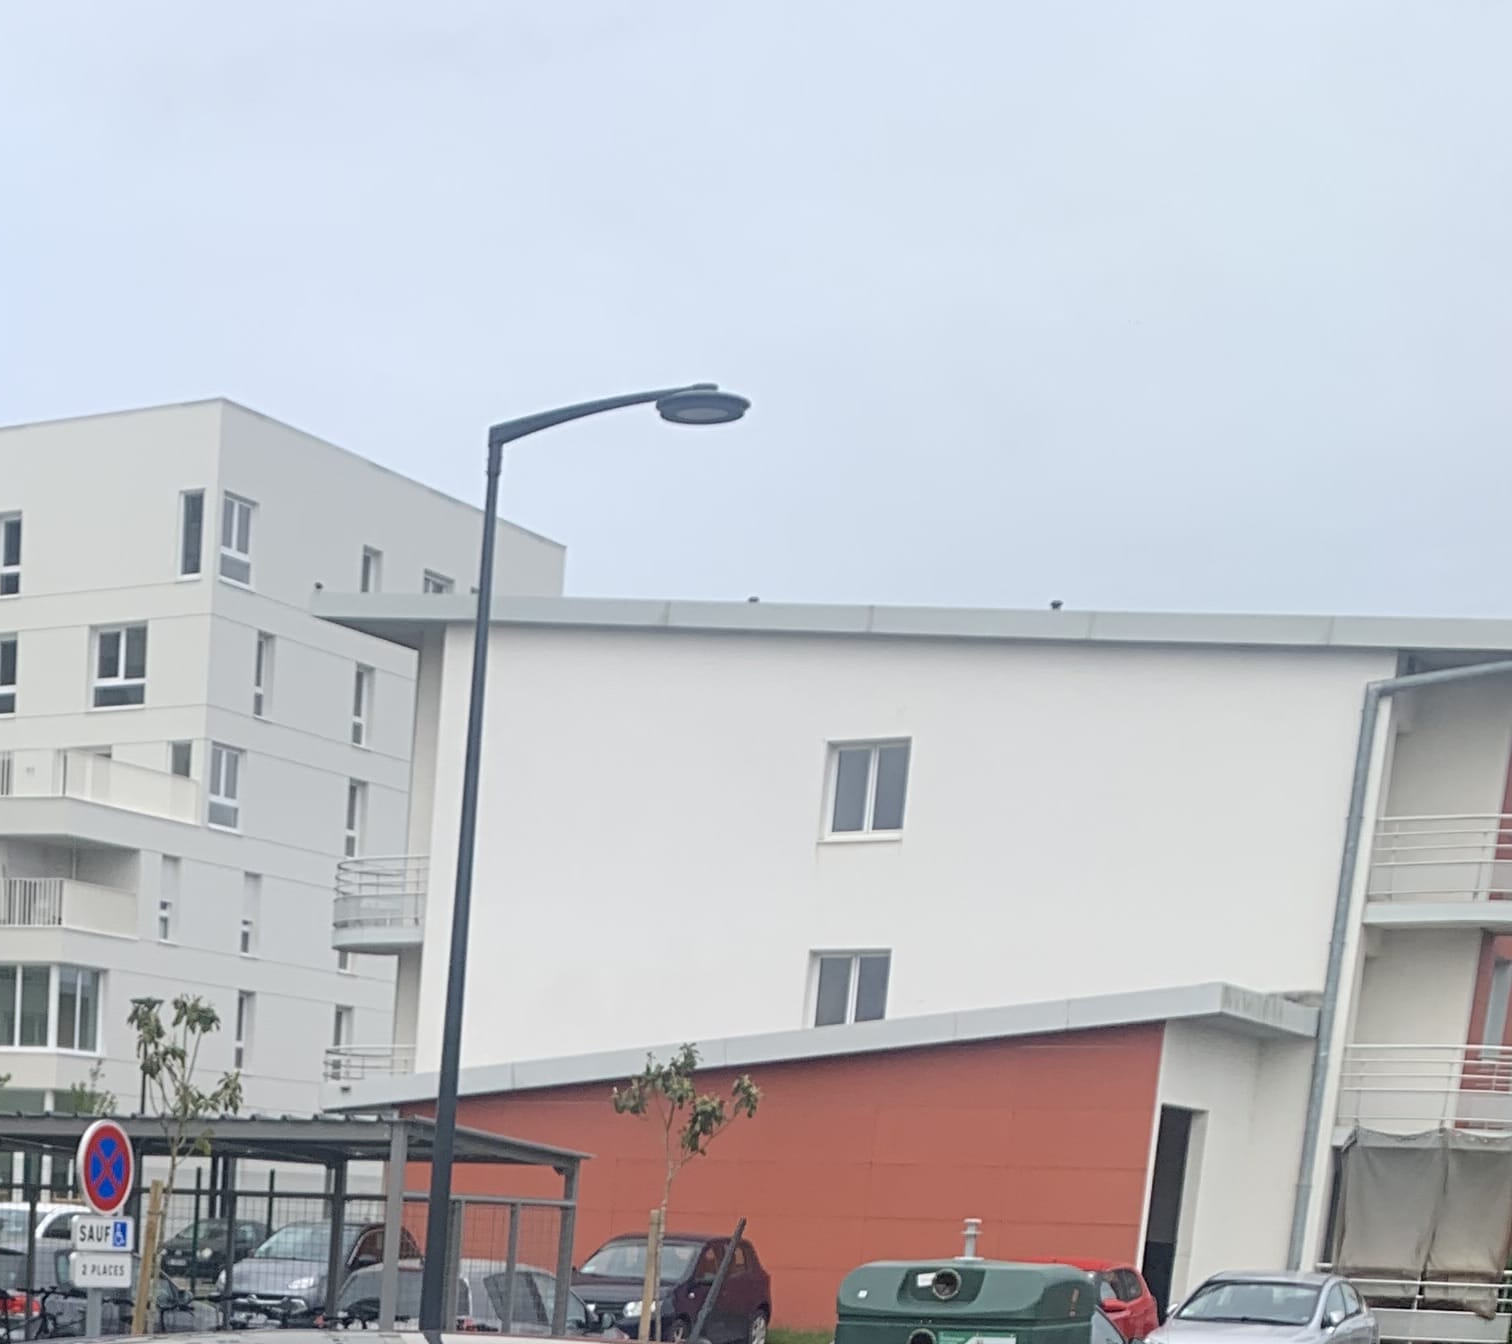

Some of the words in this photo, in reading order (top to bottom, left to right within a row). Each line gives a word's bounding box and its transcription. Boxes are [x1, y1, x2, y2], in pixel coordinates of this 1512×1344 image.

[79, 1224, 111, 1243] SAUF
[81, 1264, 88, 1276] 2
[90, 1264, 125, 1277] PLACES
